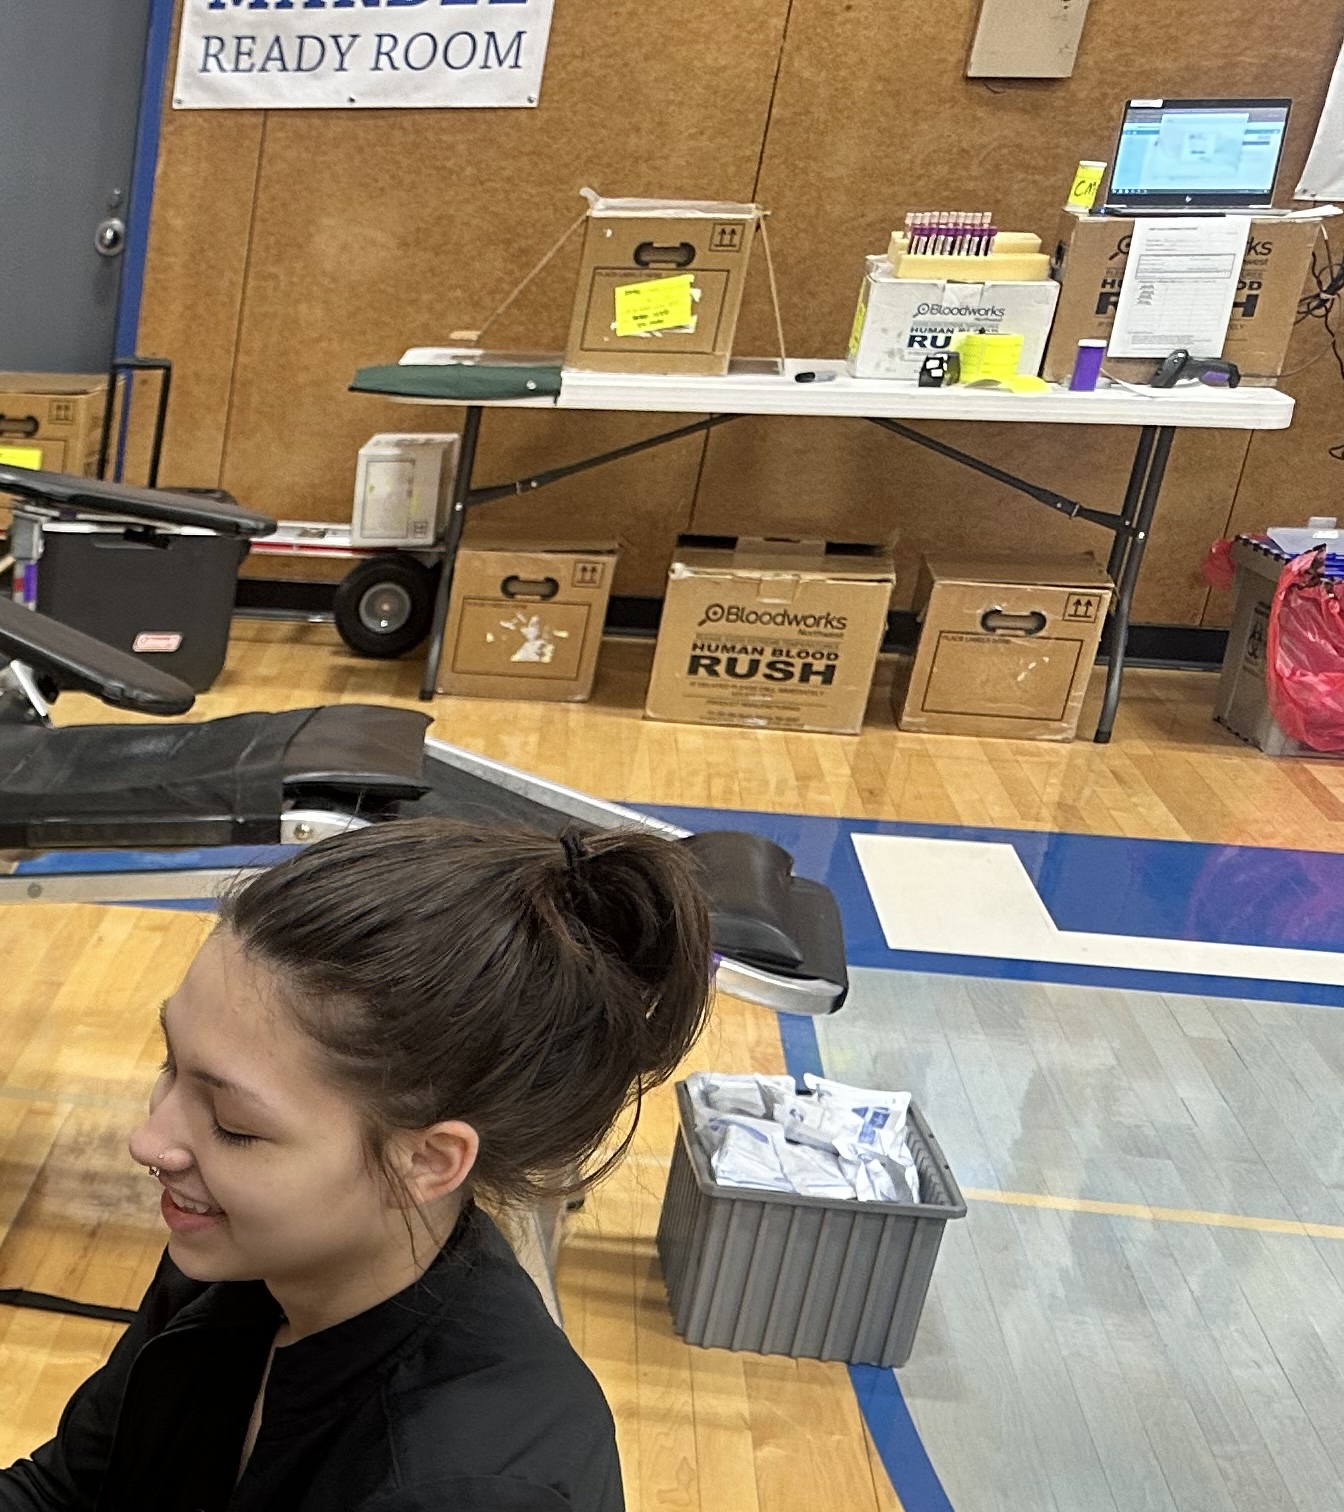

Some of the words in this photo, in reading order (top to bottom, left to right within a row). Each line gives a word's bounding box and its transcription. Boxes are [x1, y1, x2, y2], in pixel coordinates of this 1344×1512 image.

[199, 35, 361, 74] READY
[370, 30, 528, 71] ROOM
[929, 303, 1005, 318] Bloodworks
[910, 326, 955, 335] HUMAN
[906, 334, 952, 349] RU
[724, 605, 849, 631] Bloodworks
[692, 642, 765, 657] HUMAN
[770, 648, 840, 662] BLOOD
[686, 654, 837, 686] RUSH
